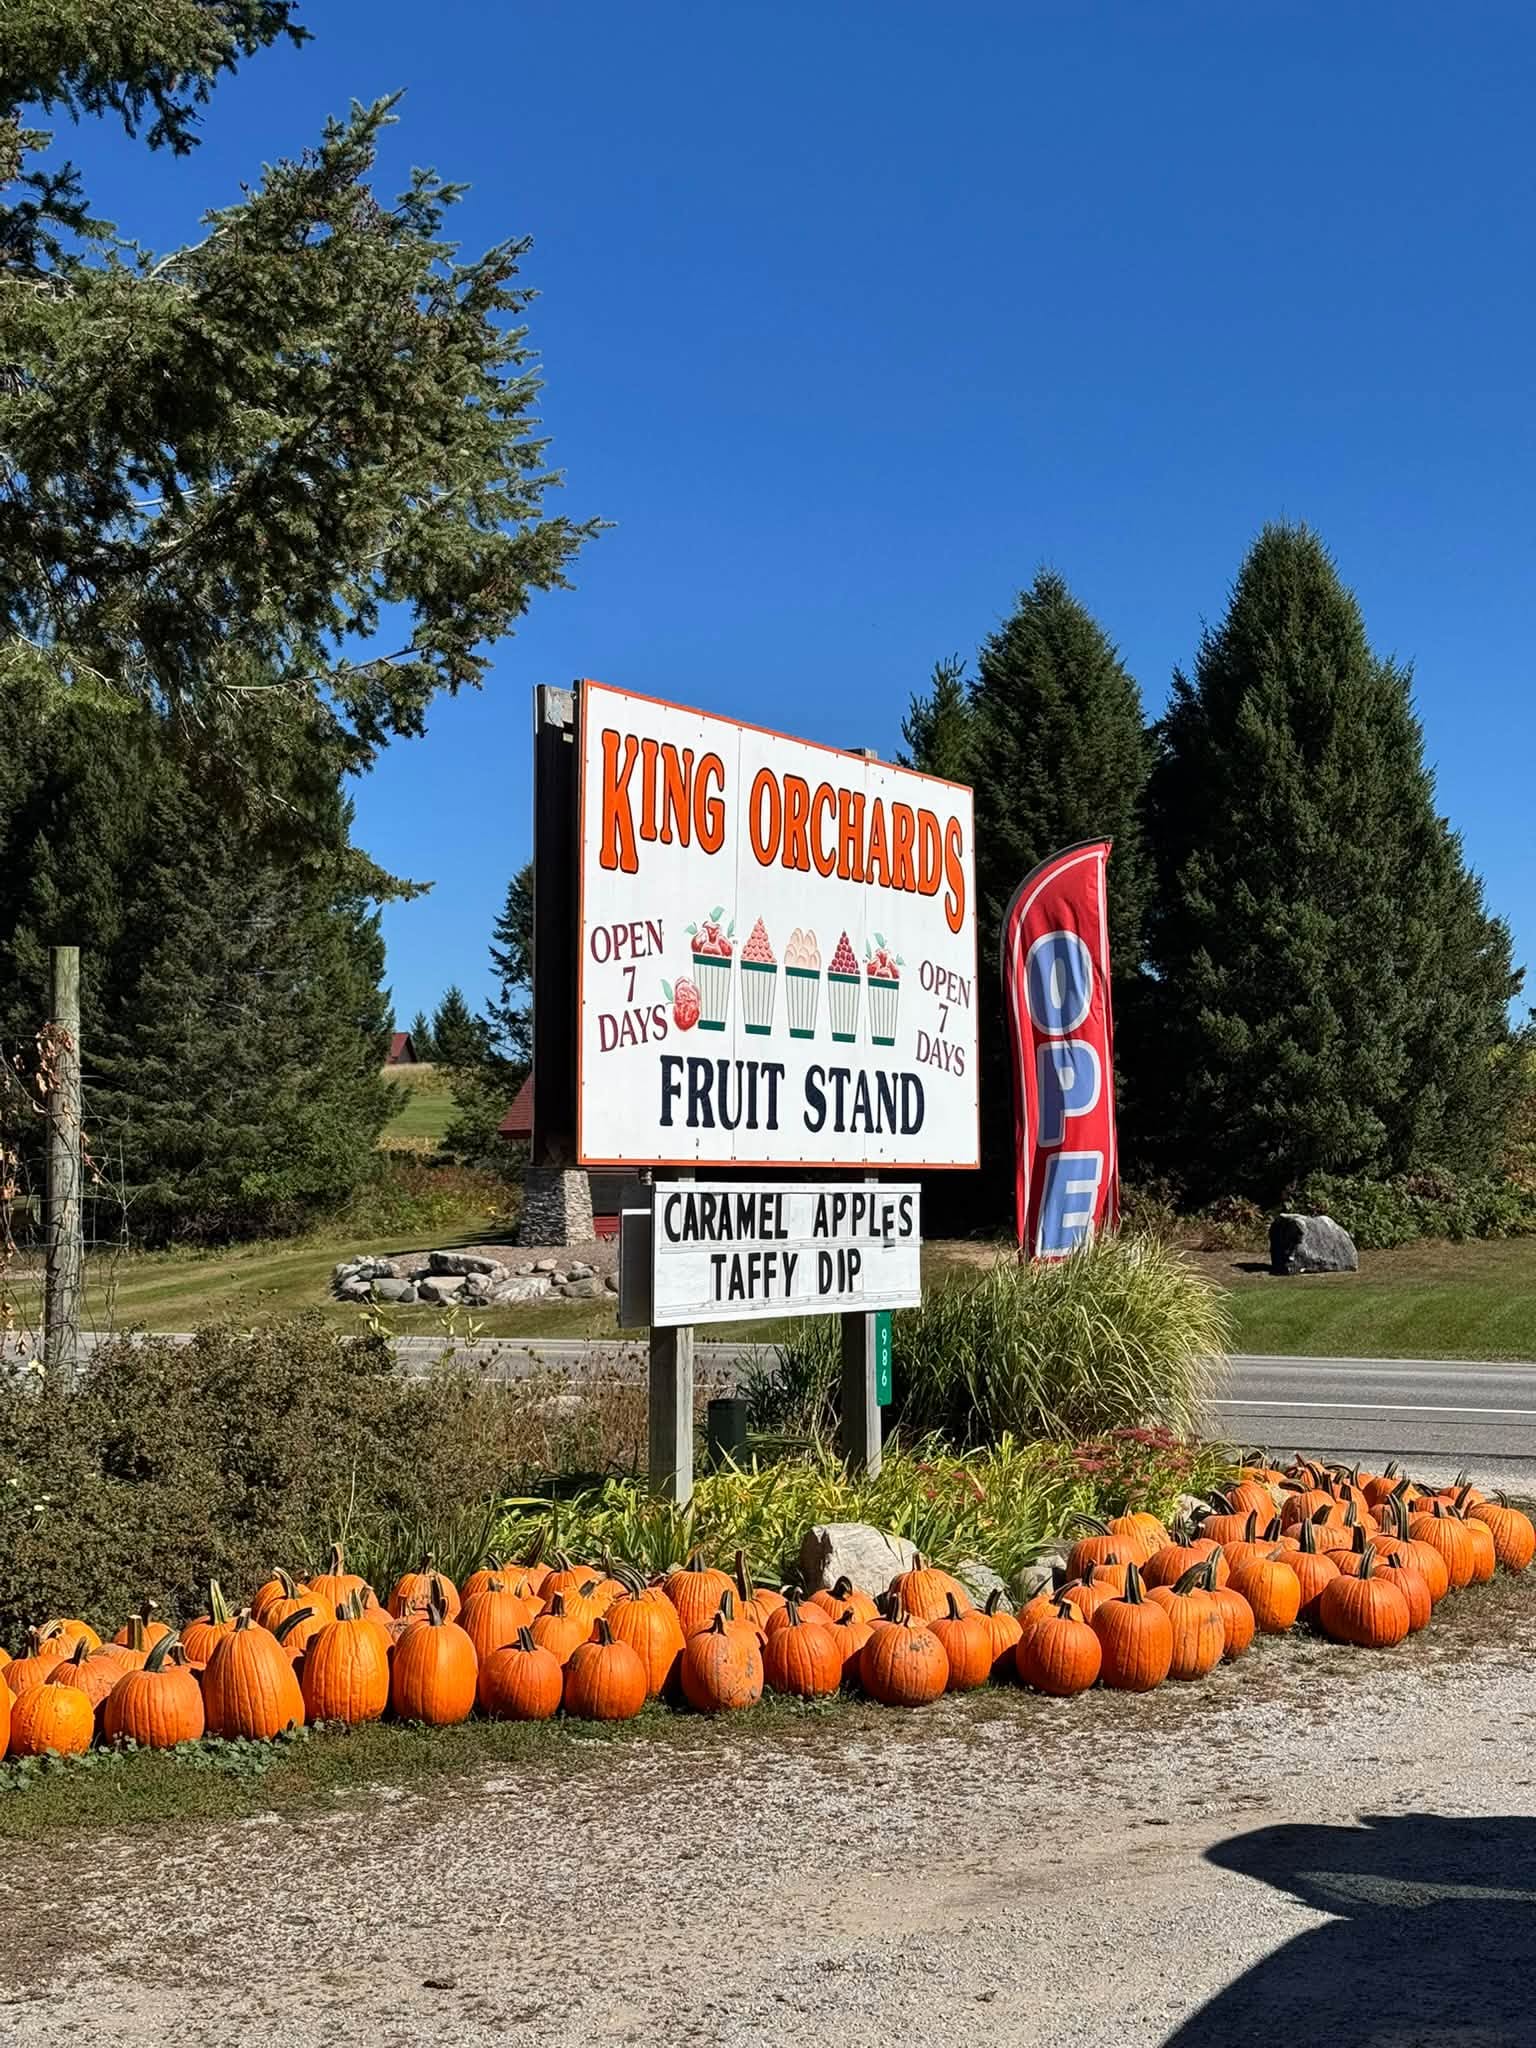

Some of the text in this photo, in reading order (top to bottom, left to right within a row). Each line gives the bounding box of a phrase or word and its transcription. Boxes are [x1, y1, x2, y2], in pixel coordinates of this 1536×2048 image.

[600, 728, 965, 934] KING ORCHARDS
[590, 919, 664, 963] OPEN
[622, 966, 636, 1002] 7
[920, 960, 971, 1009] OPEN
[598, 1004, 668, 1052] DAYS
[938, 1004, 948, 1033] 7
[916, 1030, 965, 1077] DAYS
[659, 1055, 925, 1135] FRUIT STAND
[1025, 930, 1104, 1258] OPE
[664, 1193, 912, 1248] CARAMEL APPLES
[711, 1249, 861, 1300] TAFFY DIP
